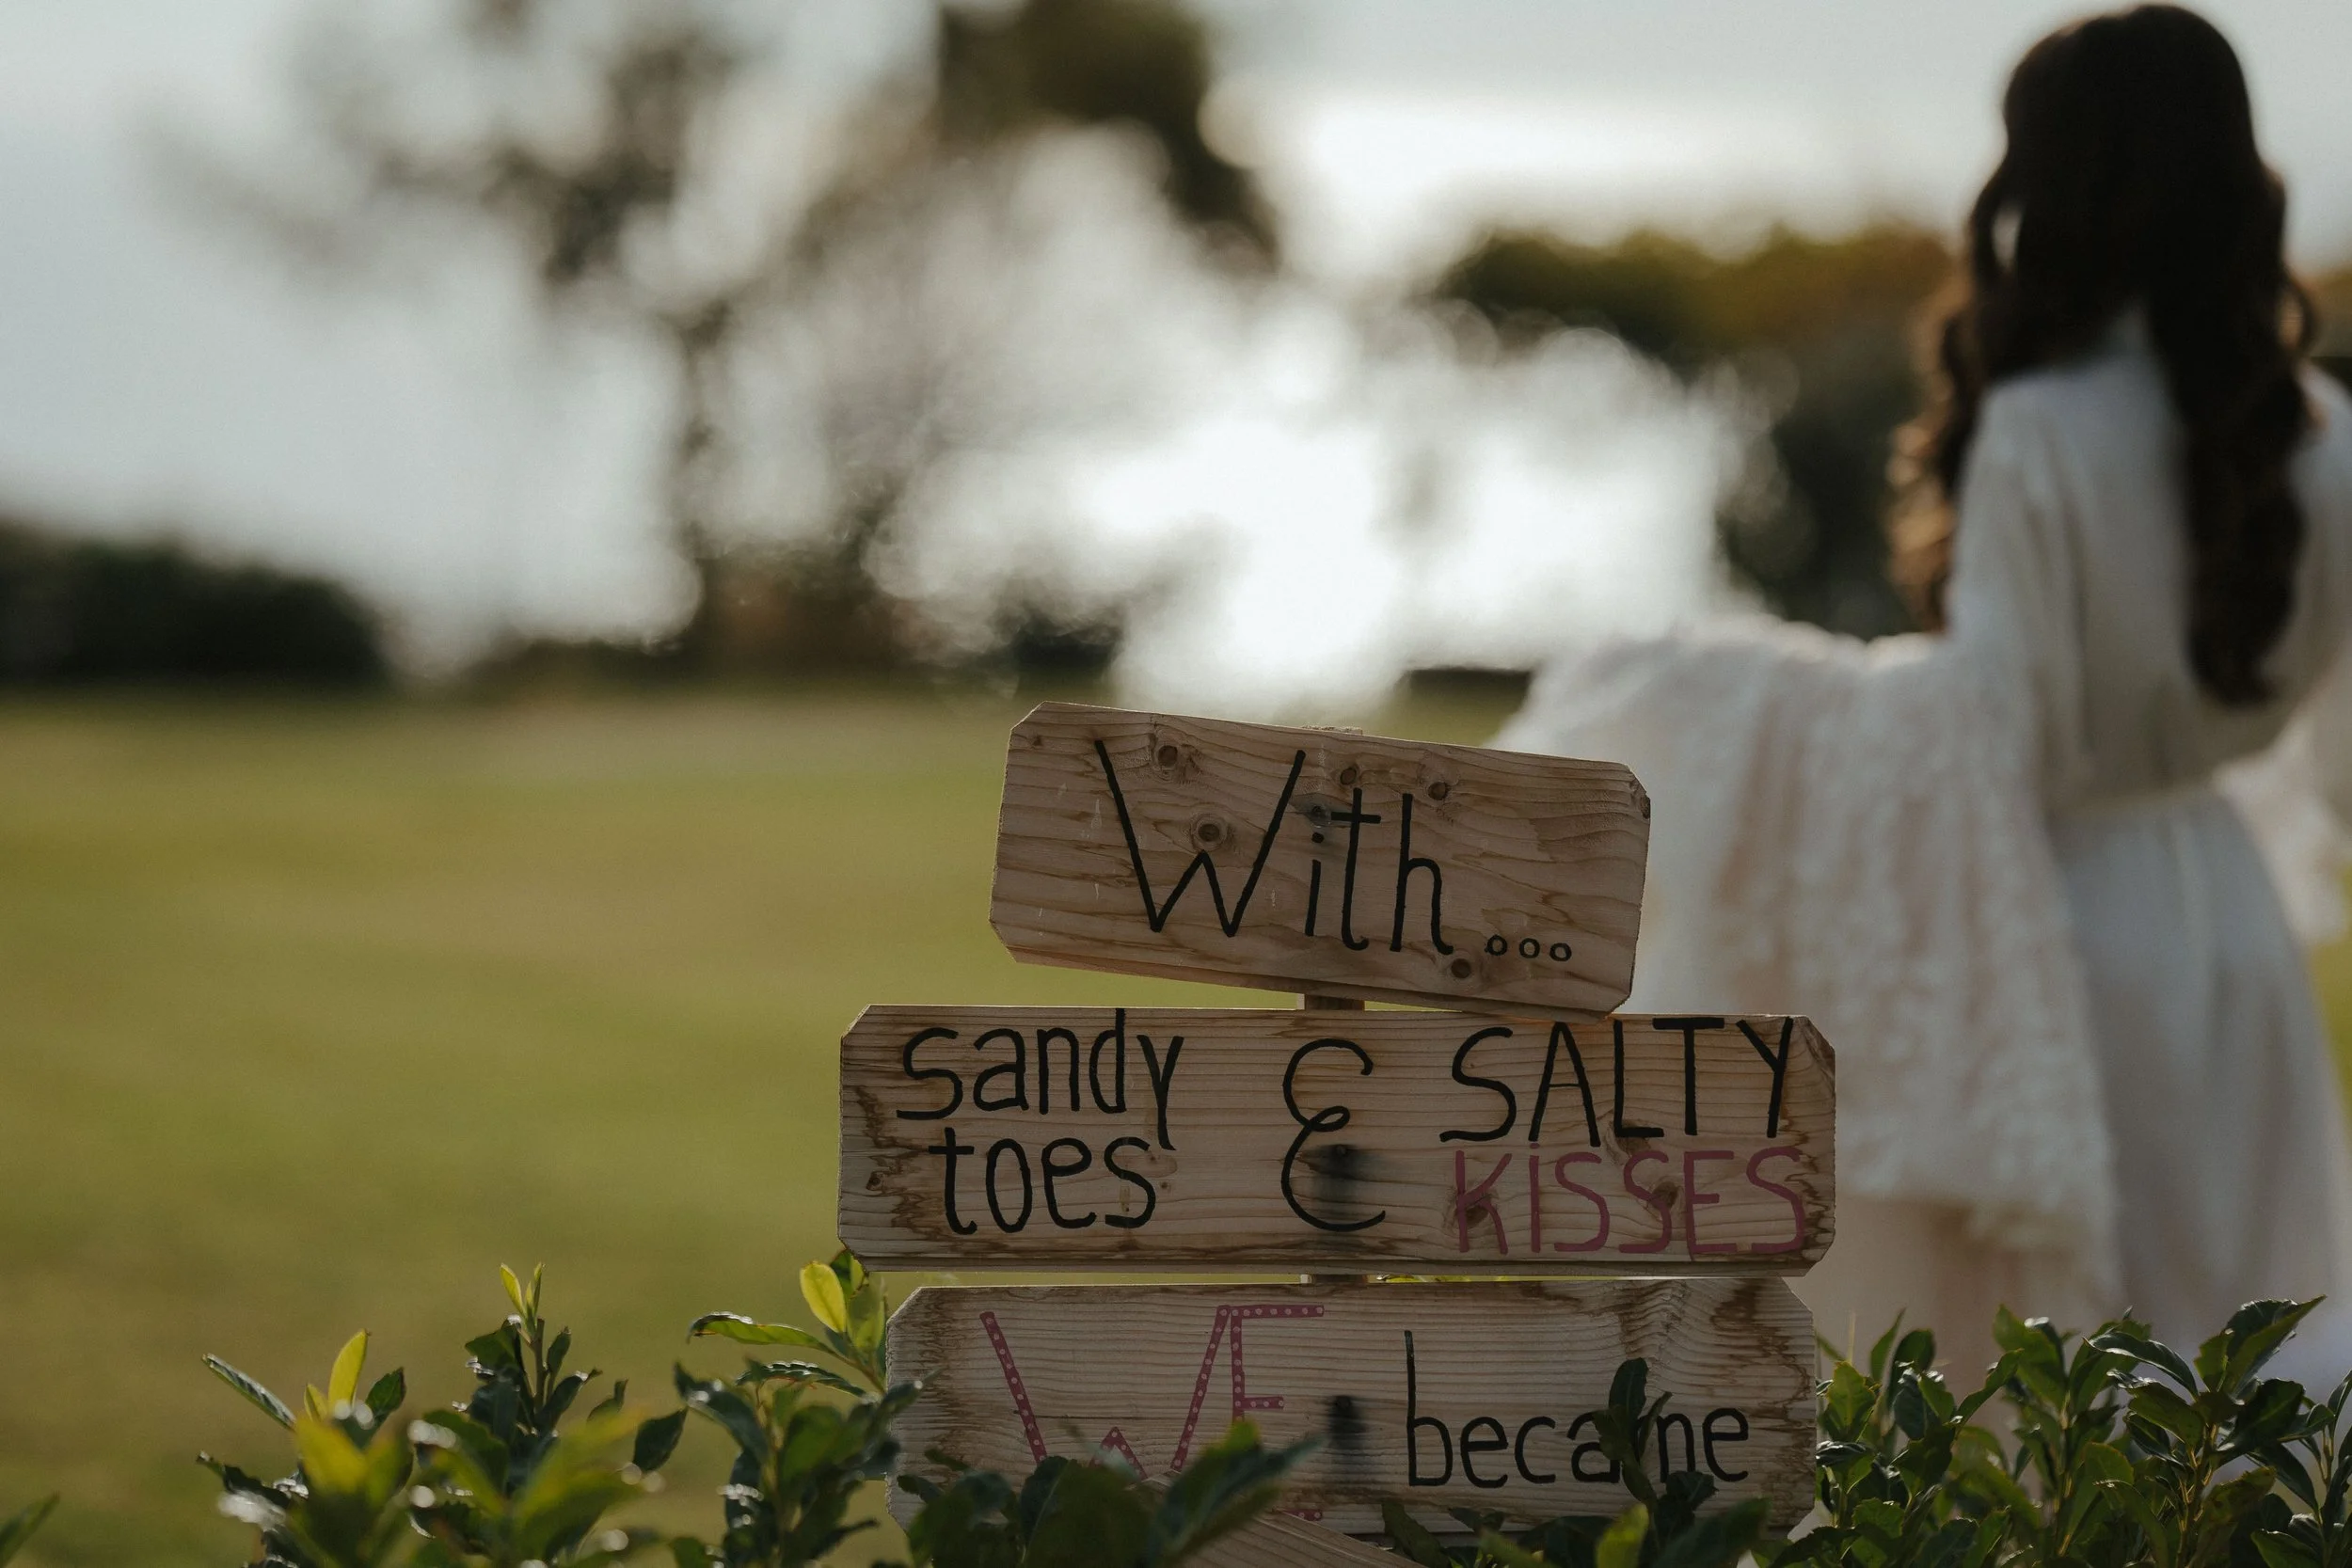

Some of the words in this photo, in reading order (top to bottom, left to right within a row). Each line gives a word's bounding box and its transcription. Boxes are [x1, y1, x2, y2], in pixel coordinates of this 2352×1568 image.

[897, 1007, 1184, 1150] sandy
[1281, 1037, 1387, 1232] &
[1439, 1017, 1794, 1147] SALTY
[928, 1128, 1157, 1234] toes
